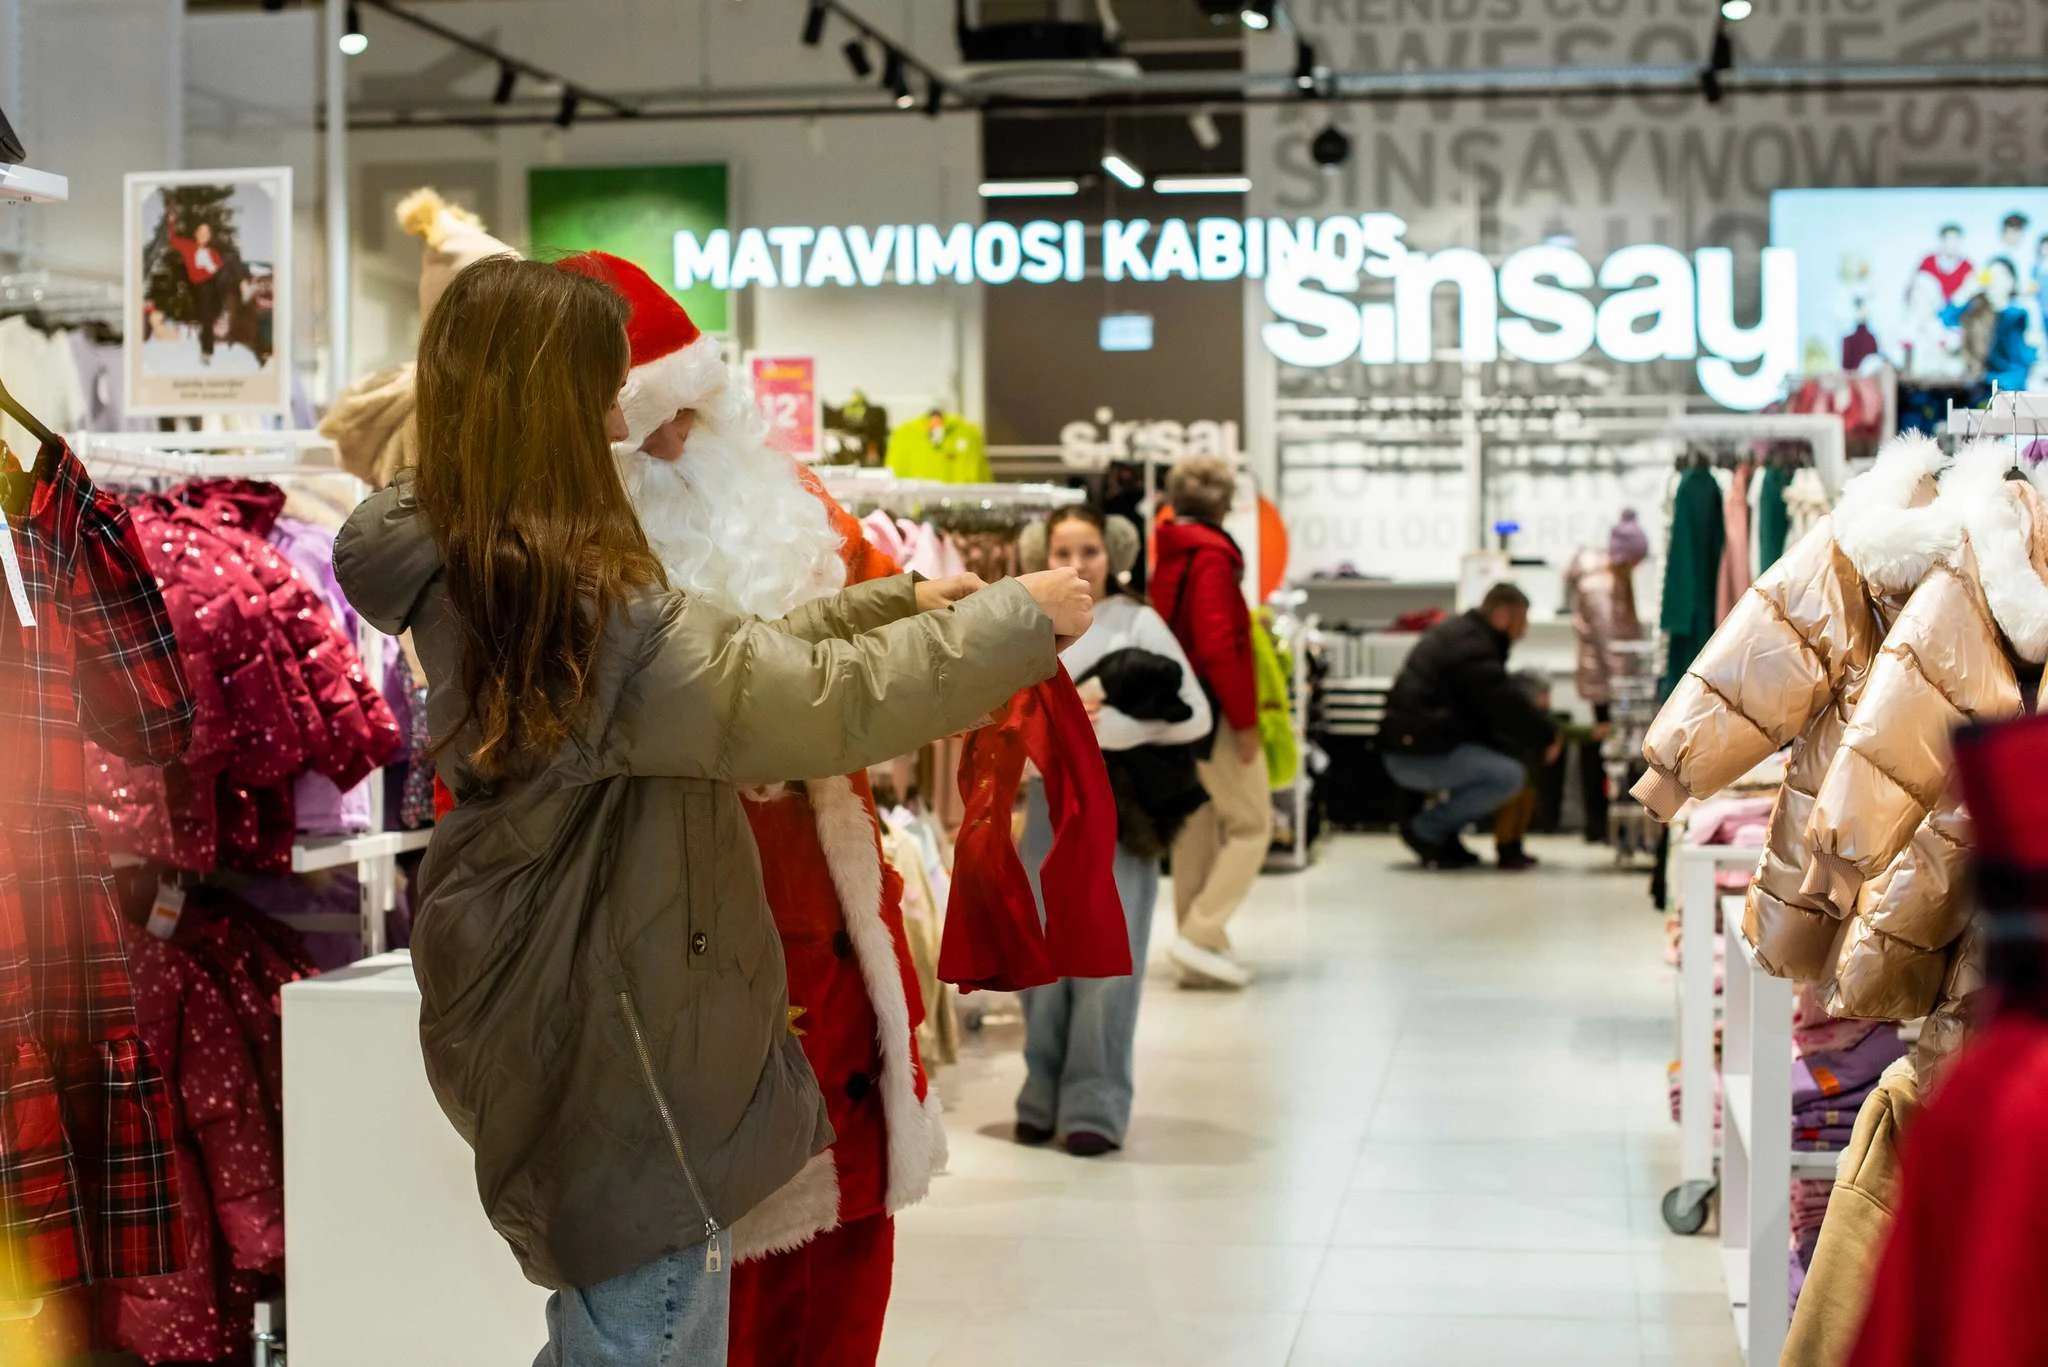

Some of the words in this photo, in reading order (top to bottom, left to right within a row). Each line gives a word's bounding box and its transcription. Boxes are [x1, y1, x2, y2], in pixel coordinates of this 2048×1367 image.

[673, 219, 1085, 290] MATAVIMOSI
[1101, 211, 1408, 291] KABINOS
[1260, 217, 1798, 412] sinsay
